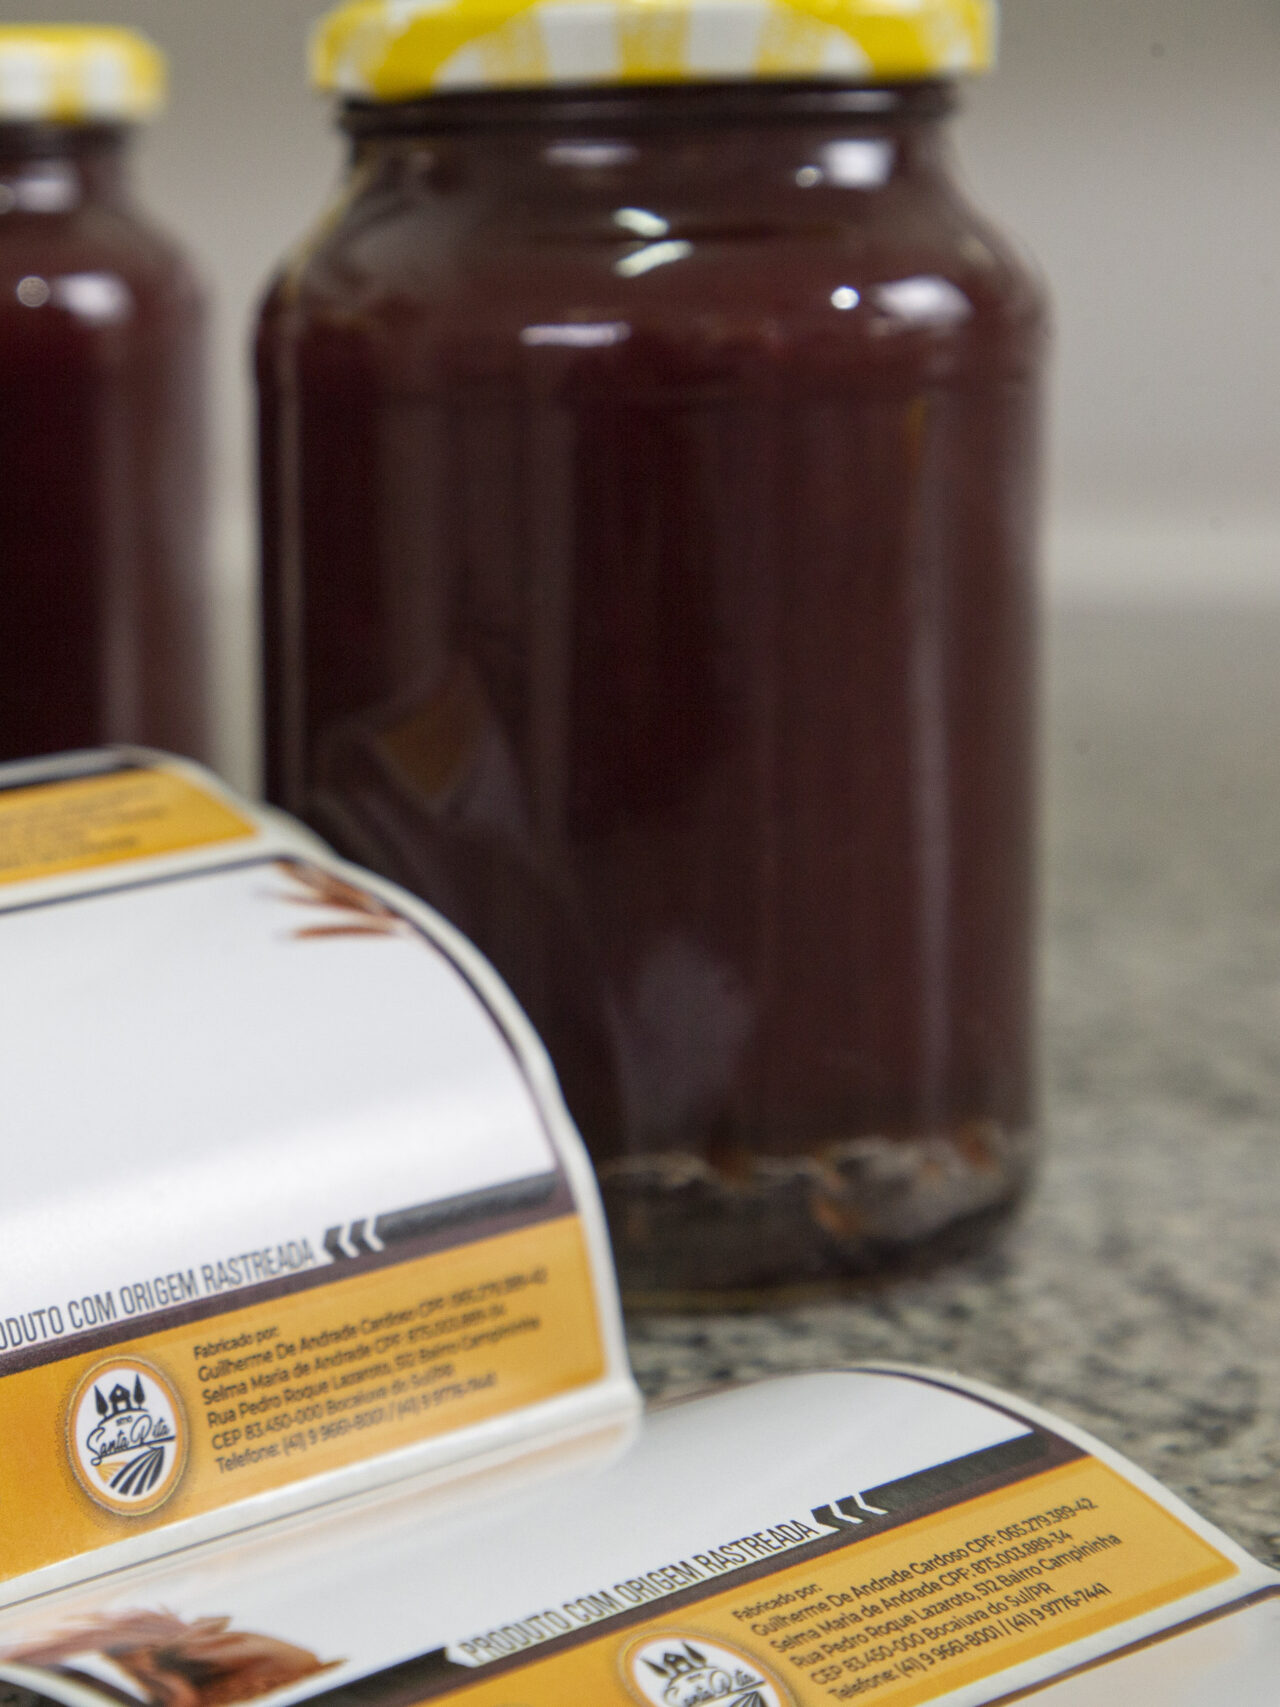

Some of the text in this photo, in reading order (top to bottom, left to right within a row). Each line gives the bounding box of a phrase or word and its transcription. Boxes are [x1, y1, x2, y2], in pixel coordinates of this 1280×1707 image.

[66, 1291, 117, 1329] COM
[118, 1268, 200, 1316] ORIGEM
[201, 1237, 316, 1294] RASTREADA
[193, 1332, 254, 1360] Fabricado
[198, 1350, 274, 1382] Guilherme
[275, 1342, 297, 1360] De
[202, 1381, 248, 1405] Selma
[250, 1367, 290, 1390] Maria
[292, 1361, 311, 1379] de
[207, 1408, 237, 1429] Rua
[238, 1395, 282, 1418] Pedro
[283, 1380, 330, 1403] Roque
[86, 1426, 130, 1467] Santa
[211, 1427, 242, 1450] CEP
[458, 1519, 821, 1667] PRODUTO COM ORIGEM RASTREADA
[750, 1497, 1099, 1637] Guilherme De Andrade Cardoso CPF: 065.279.389-42
[769, 1529, 1074, 1654] Selma Maria de Andrade CPF: 875.003.889-34
[789, 1533, 1123, 1669] Rua Pedro Roque Lazaroto, 512 Bairro Campininha
[732, 1583, 823, 1622] Fabricado por:
[809, 1582, 1057, 1685] CEP 83.450-000 Bocaiuva do Sul/PR
[827, 1668, 901, 1702] Telefone:
[893, 1656, 928, 1679] (41)
[918, 1652, 936, 1666] 9
[930, 1625, 1005, 1661] 9661-8001
[1005, 1611, 1039, 1633] (41)
[1029, 1608, 1046, 1621] 9
[1040, 1582, 1113, 1617] 9776-7441
